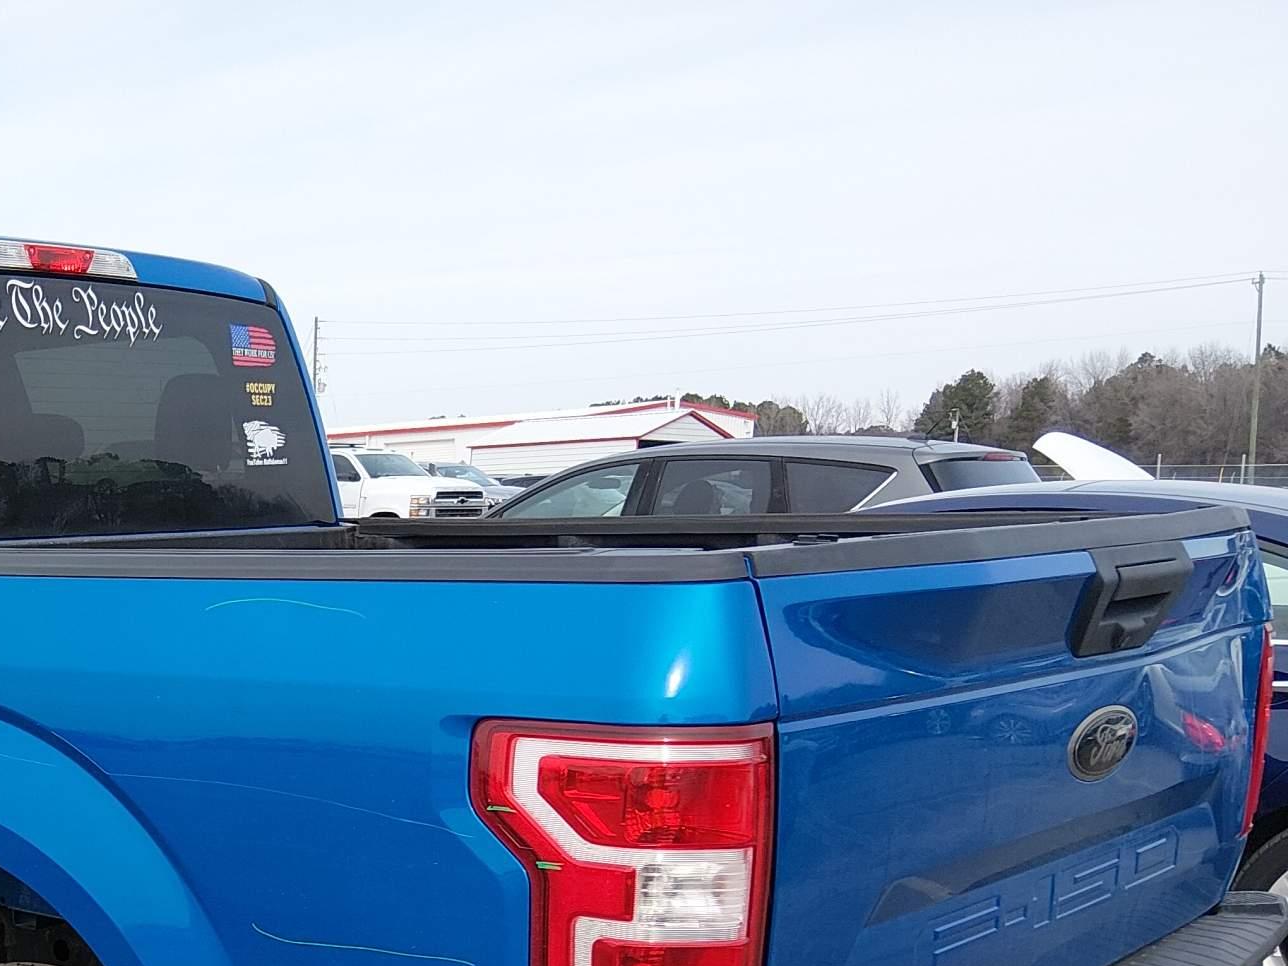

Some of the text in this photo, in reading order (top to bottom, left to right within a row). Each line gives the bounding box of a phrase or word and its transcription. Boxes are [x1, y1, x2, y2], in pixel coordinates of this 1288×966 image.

[6, 279, 69, 336] The
[72, 284, 162, 347] People
[246, 382, 276, 394] #OCCUPY
[251, 394, 273, 406] SEC23
